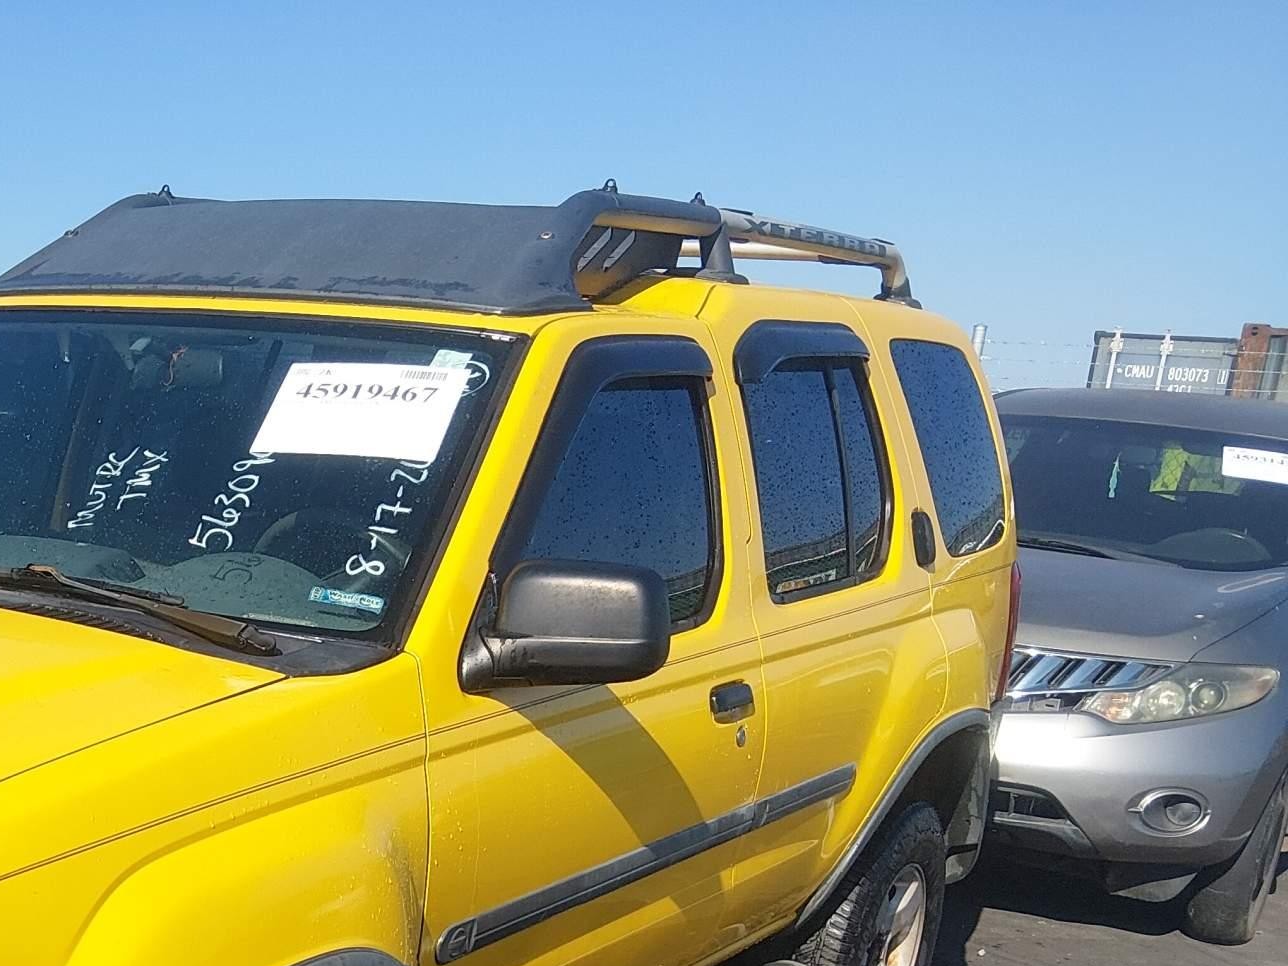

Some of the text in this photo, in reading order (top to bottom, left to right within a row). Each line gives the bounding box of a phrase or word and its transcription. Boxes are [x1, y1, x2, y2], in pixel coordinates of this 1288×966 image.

[1124, 364, 1155, 379] CMAU
[1167, 367, 1210, 382] 803073
[295, 381, 440, 403] 45919467
